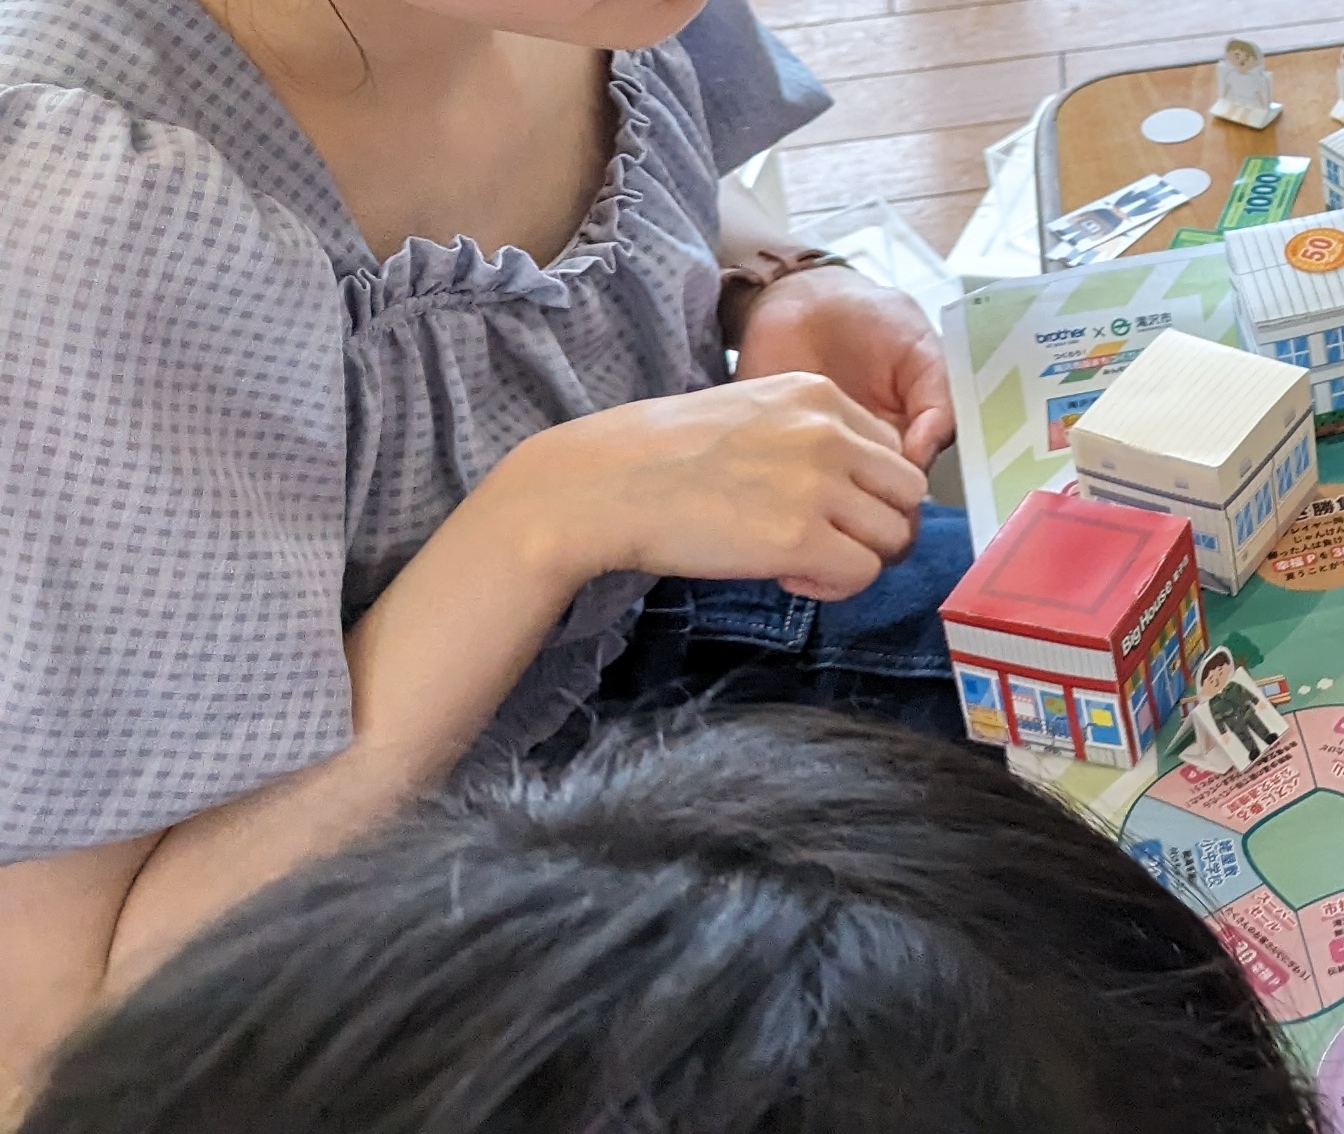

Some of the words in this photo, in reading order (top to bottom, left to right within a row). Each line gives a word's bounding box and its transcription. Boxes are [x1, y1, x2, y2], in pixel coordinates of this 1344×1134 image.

[1245, 172, 1281, 215] 1000
[1299, 235, 1333, 262] 50
[1035, 327, 1087, 343] brother
